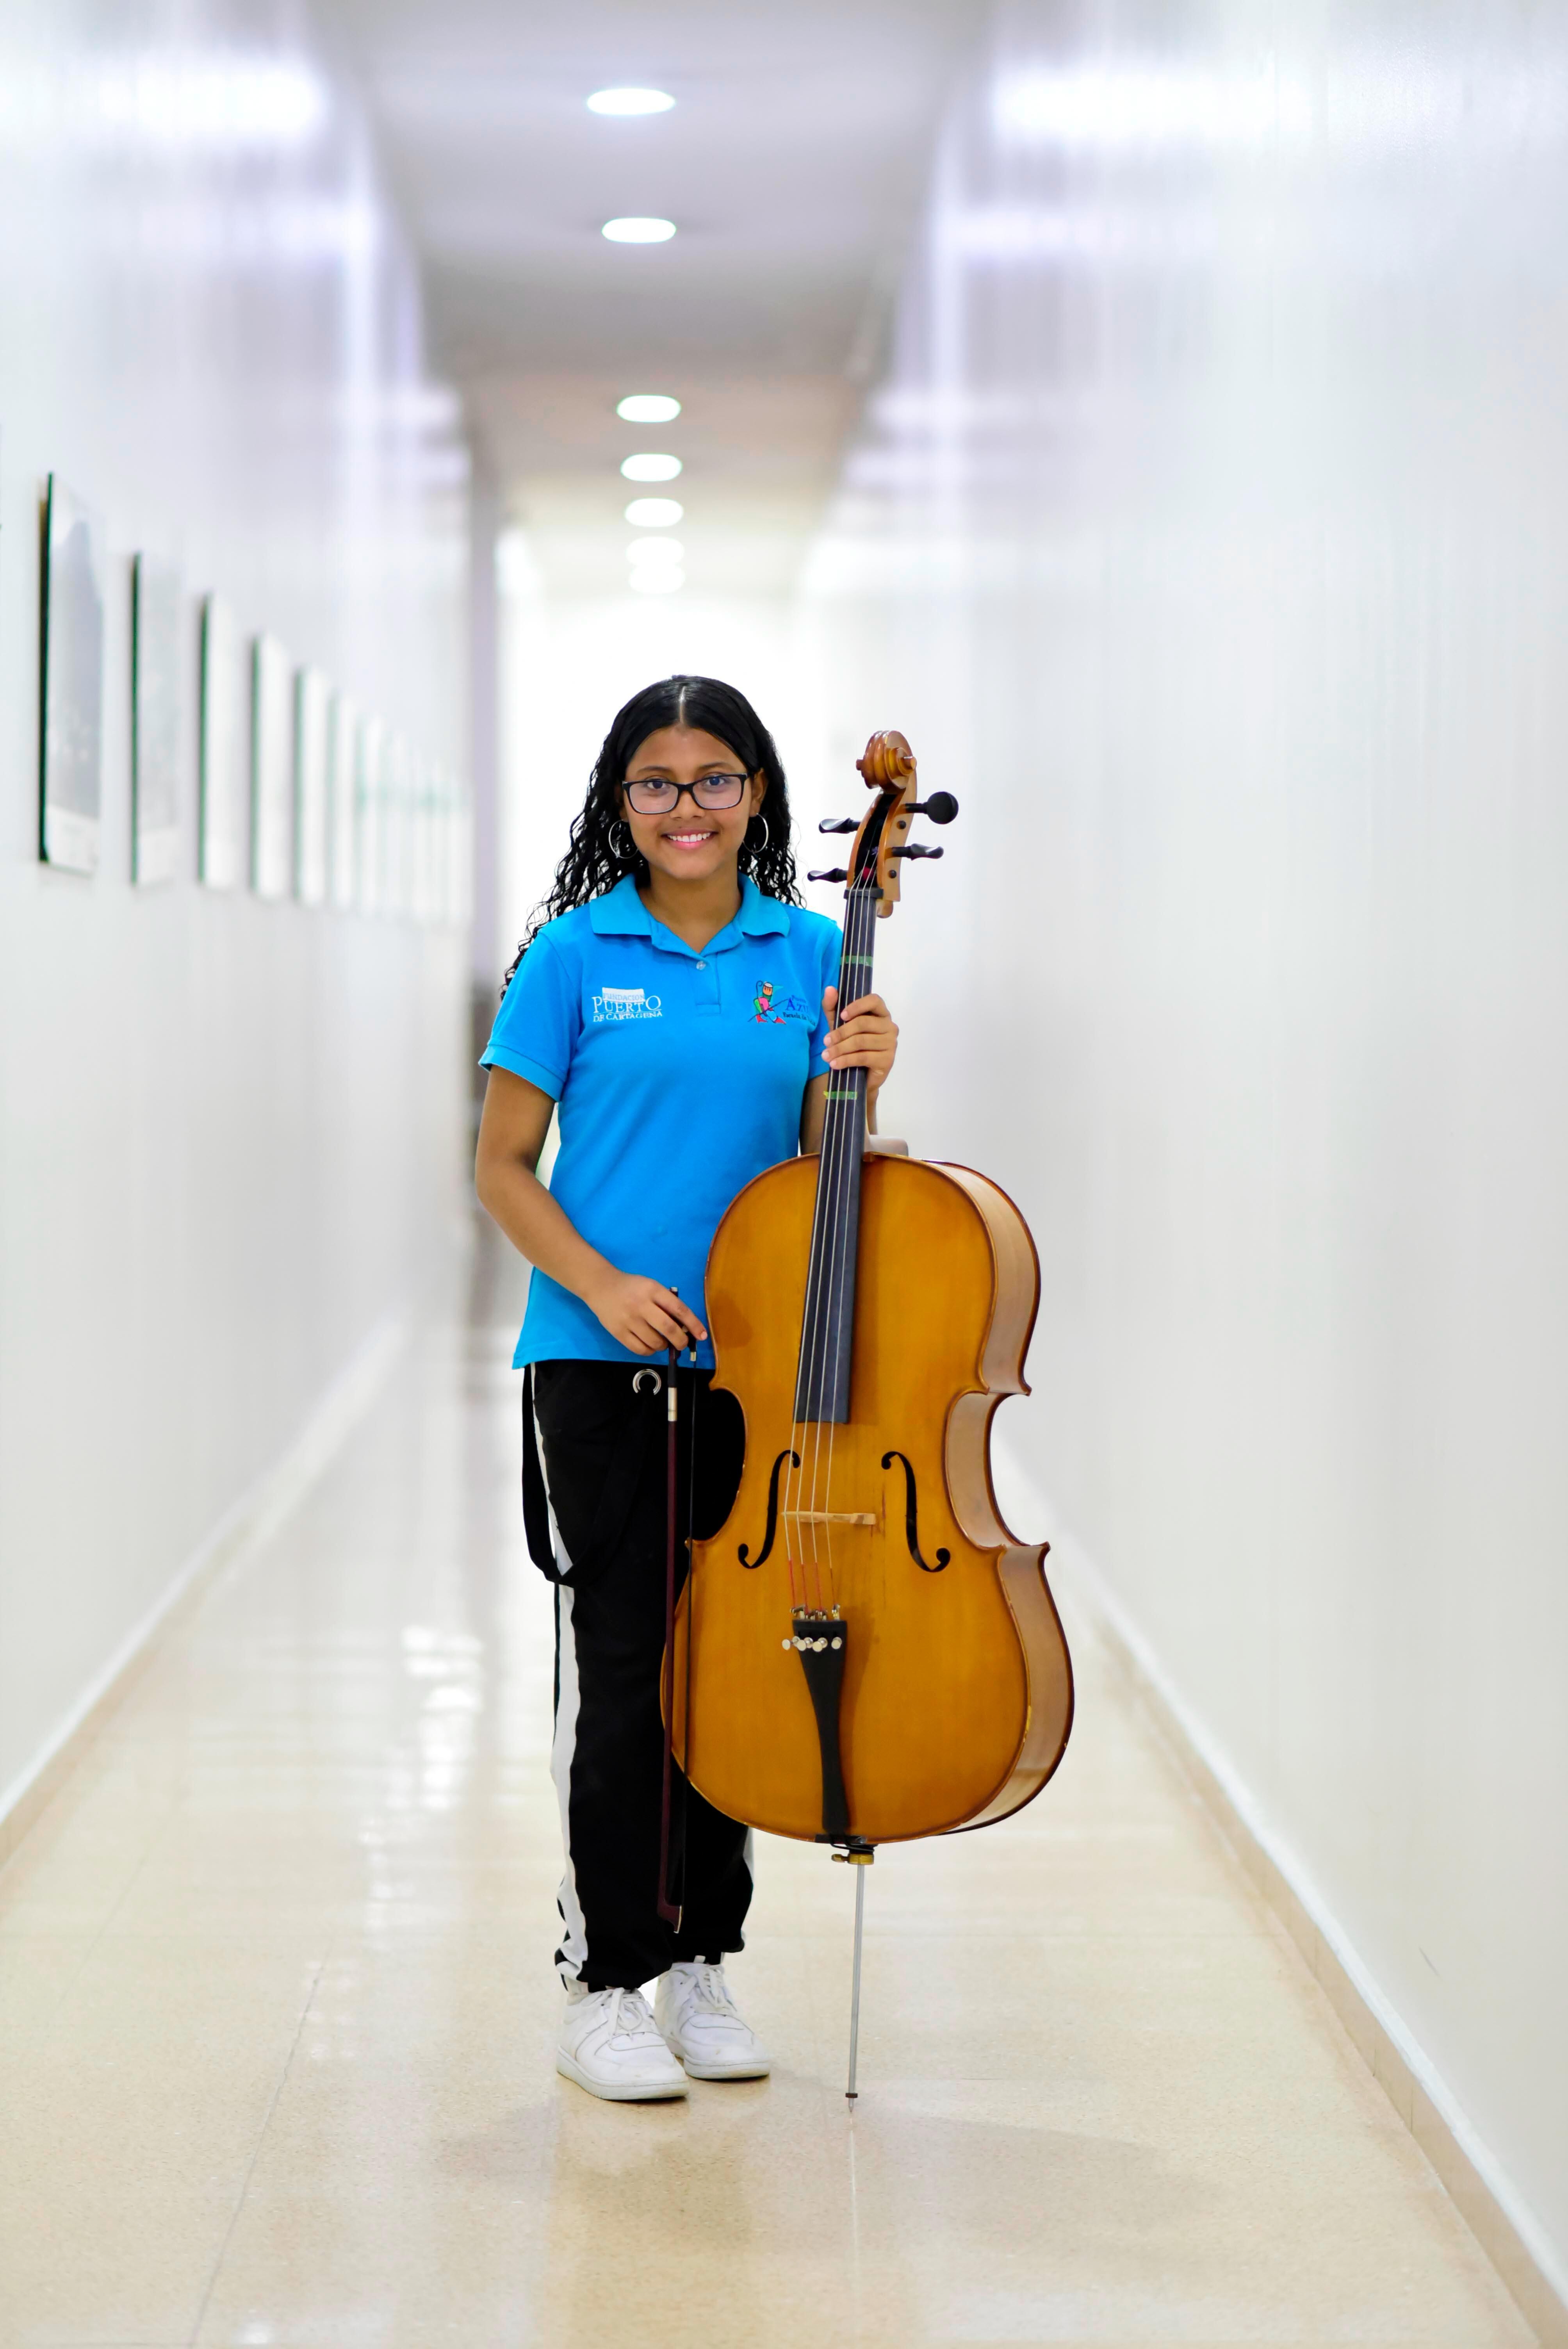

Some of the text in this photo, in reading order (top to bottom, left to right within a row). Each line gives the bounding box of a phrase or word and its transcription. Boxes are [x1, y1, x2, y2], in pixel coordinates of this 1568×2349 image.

[592, 995, 661, 1014] PUERTO
[593, 1011, 663, 1022] DE CARTAGENA
